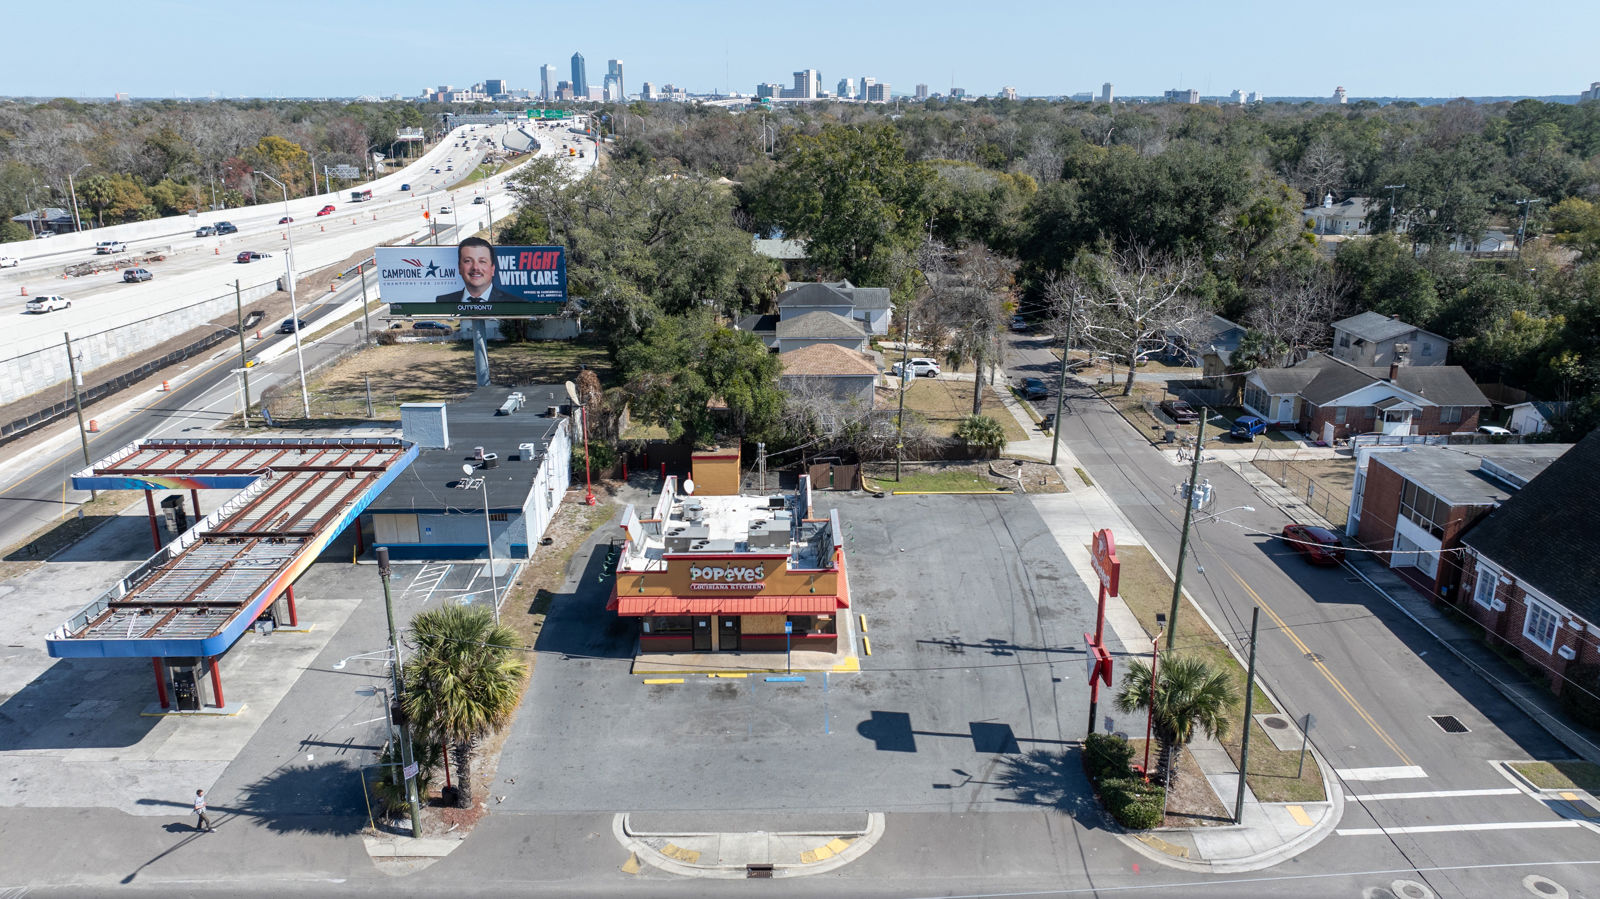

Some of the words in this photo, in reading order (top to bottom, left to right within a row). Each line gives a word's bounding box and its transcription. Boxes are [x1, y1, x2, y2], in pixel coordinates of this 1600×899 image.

[497, 255, 516, 270] WE
[518, 251, 560, 270] FIGHT
[382, 268, 422, 279] CAMPIONE
[439, 268, 456, 278] LAW
[498, 270, 528, 286] WITH
[530, 270, 559, 286] CARE
